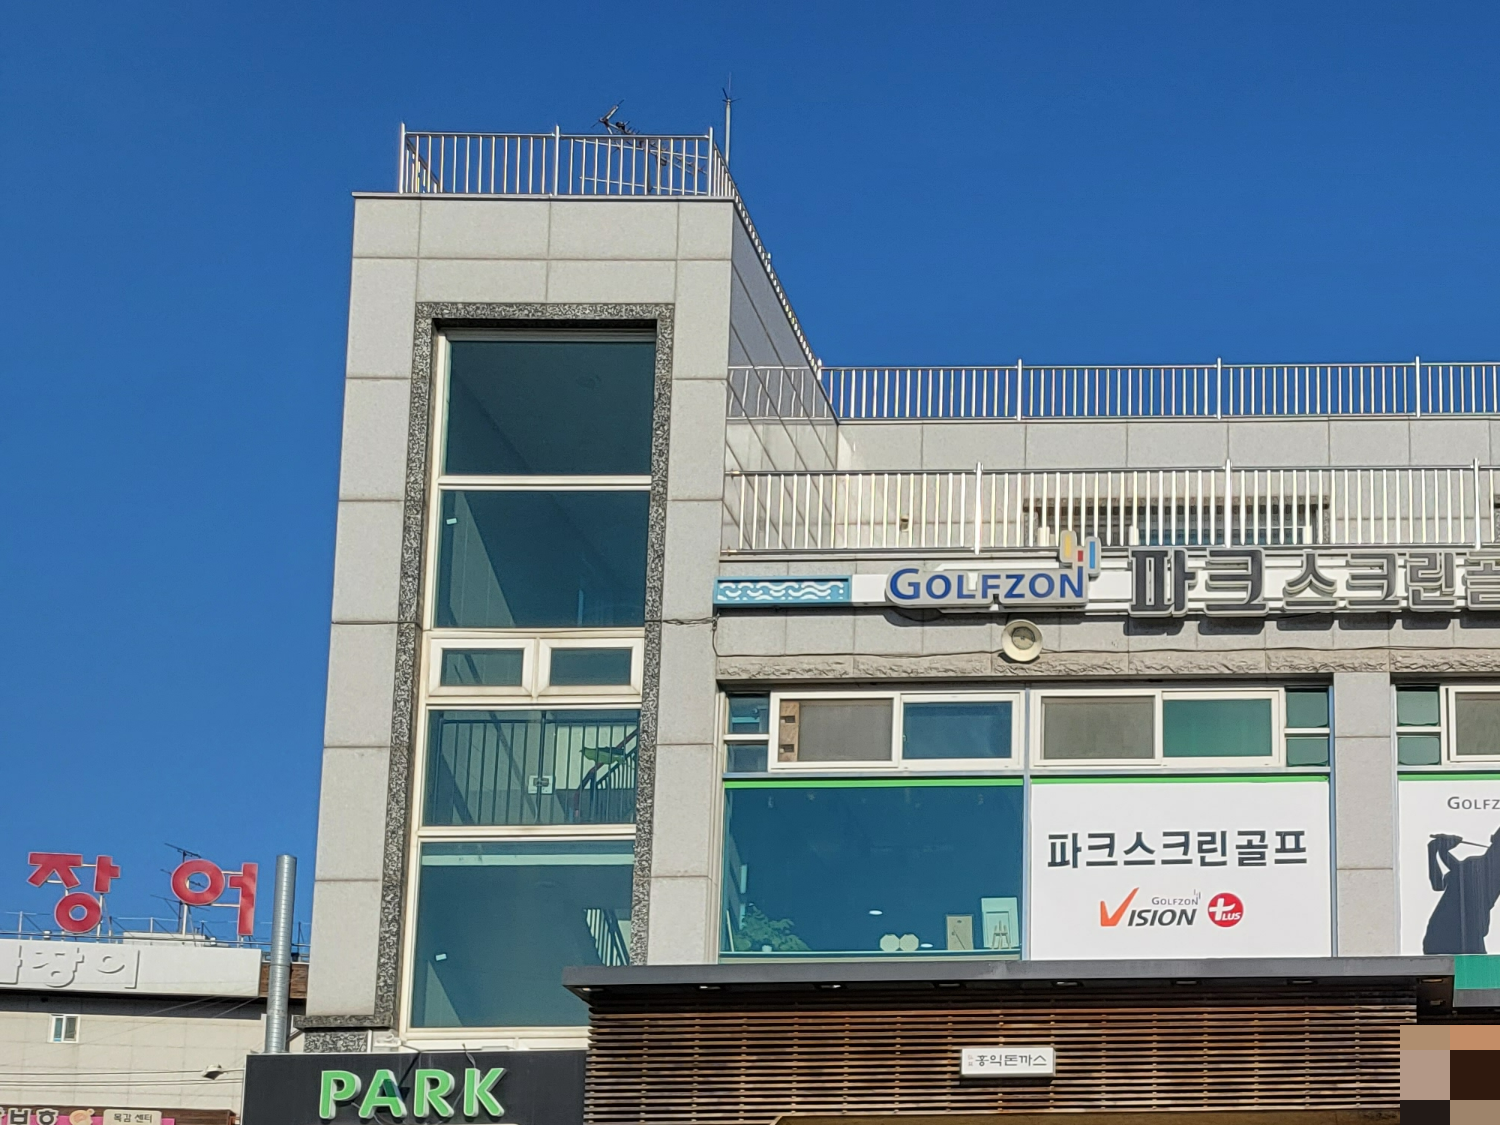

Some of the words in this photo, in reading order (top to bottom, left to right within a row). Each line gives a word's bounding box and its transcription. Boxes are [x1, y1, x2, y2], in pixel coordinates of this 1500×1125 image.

[889, 566, 1085, 601] GOLFZON
[1047, 831, 1307, 867] 파크스크린골프
[27, 852, 259, 935] 장어
[1100, 887, 1197, 927] VISION
[1151, 896, 1198, 906] GOLFZON
[975, 1054, 1047, 1067] 홍익돈까스
[319, 1068, 506, 1119] PARK
[134, 1112, 153, 1124] 센터
